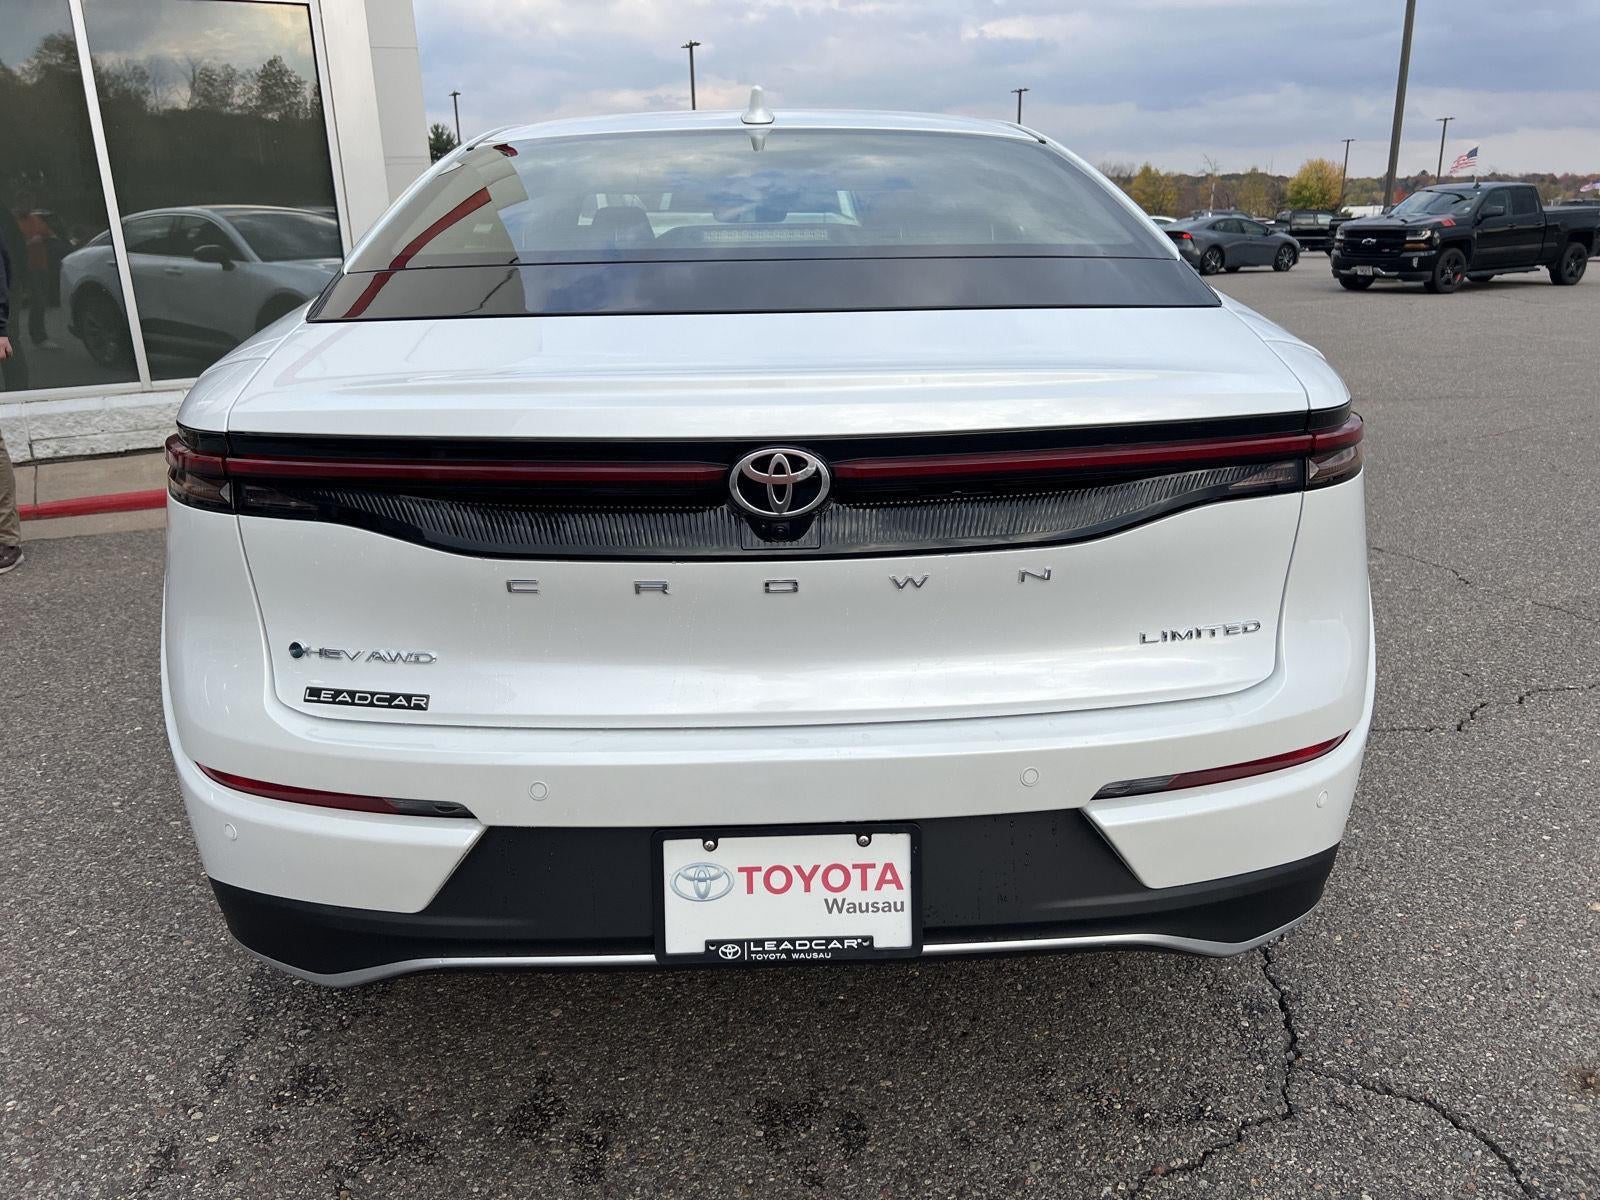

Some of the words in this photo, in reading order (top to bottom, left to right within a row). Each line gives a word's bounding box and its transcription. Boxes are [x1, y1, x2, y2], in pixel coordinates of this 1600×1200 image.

[506, 566, 1052, 595] CROWN
[1139, 619, 1261, 645] LIMITED
[364, 651, 437, 664] AWD
[305, 689, 427, 708] LEADCAR
[737, 862, 904, 895] TOYOTA
[824, 897, 905, 914] Wausau
[750, 939, 858, 951] LEADCAR
